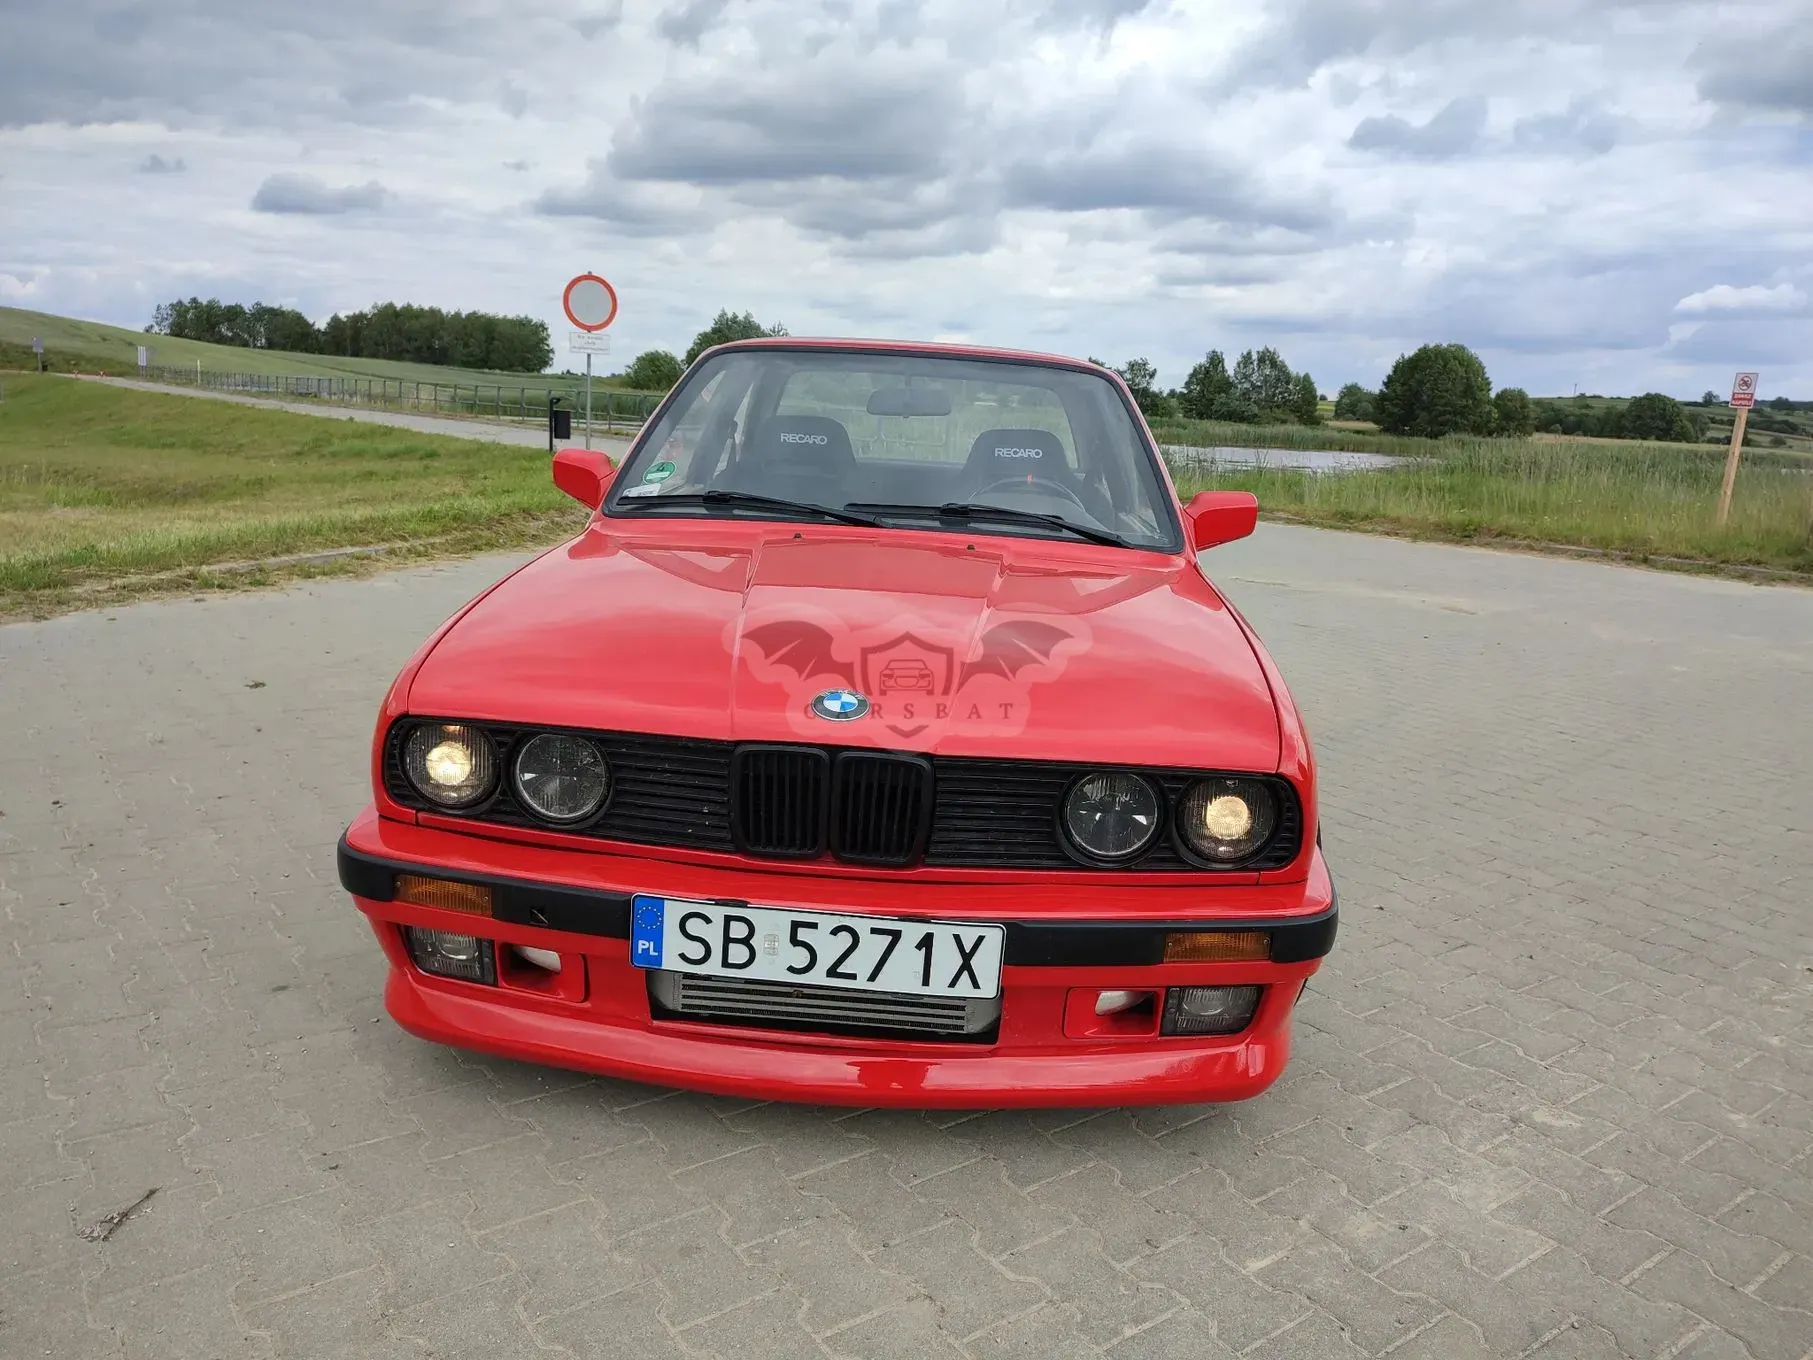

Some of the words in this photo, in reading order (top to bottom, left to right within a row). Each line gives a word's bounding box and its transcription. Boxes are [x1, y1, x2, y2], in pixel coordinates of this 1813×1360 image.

[780, 433, 828, 445] RECARO
[994, 447, 1043, 459] RECARO
[637, 940, 659, 957] PL
[677, 911, 758, 970] SB
[785, 919, 987, 990] 5271X
